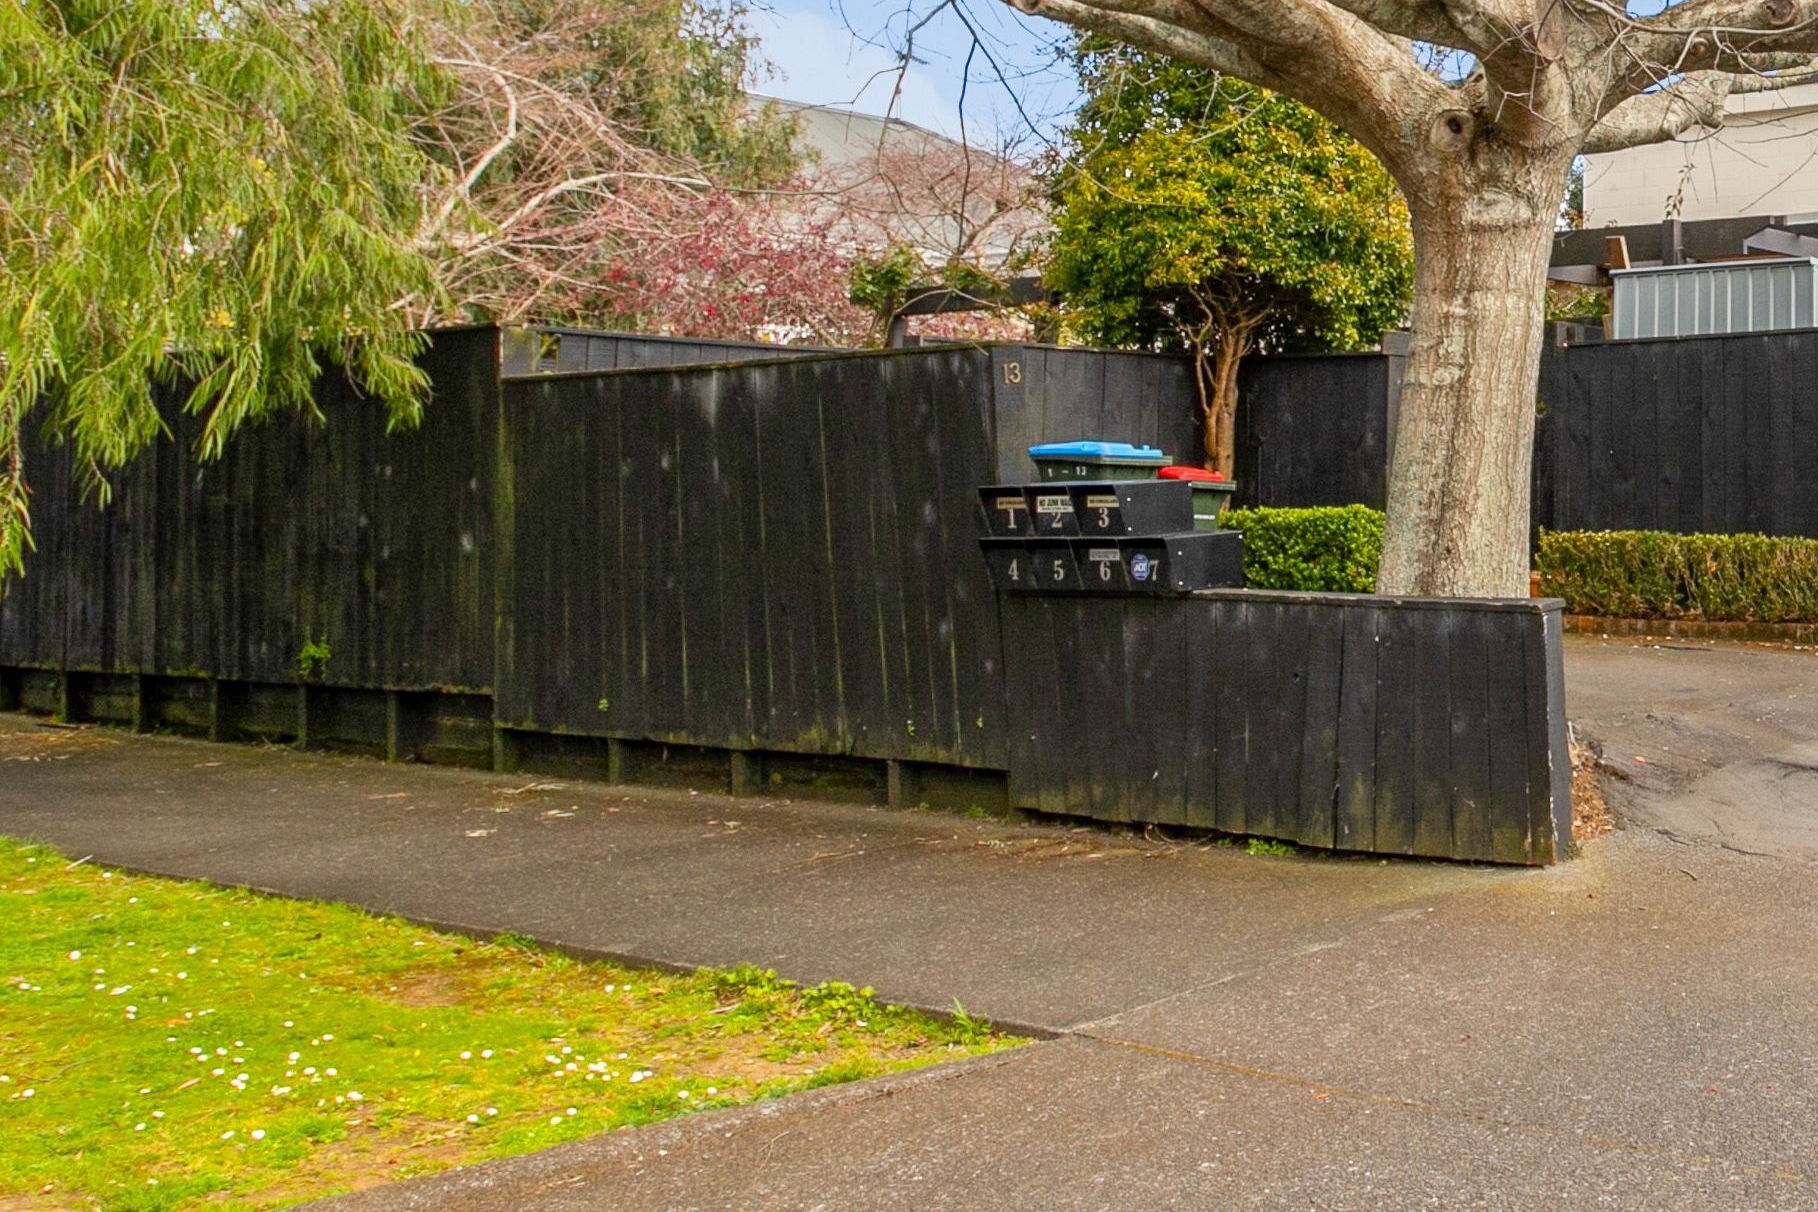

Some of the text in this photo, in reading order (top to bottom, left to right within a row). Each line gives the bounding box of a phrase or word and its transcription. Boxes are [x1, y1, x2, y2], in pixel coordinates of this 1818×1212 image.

[1003, 362, 1021, 384] 13
[1047, 467, 1053, 477] 1
[1007, 508, 1017, 529] 1
[1051, 511, 1063, 528] 2
[1098, 507, 1109, 528] 3
[1008, 558, 1019, 580] 4
[1053, 559, 1064, 581] 5
[1100, 560, 1111, 581] 6
[1149, 560, 1159, 581] 7
